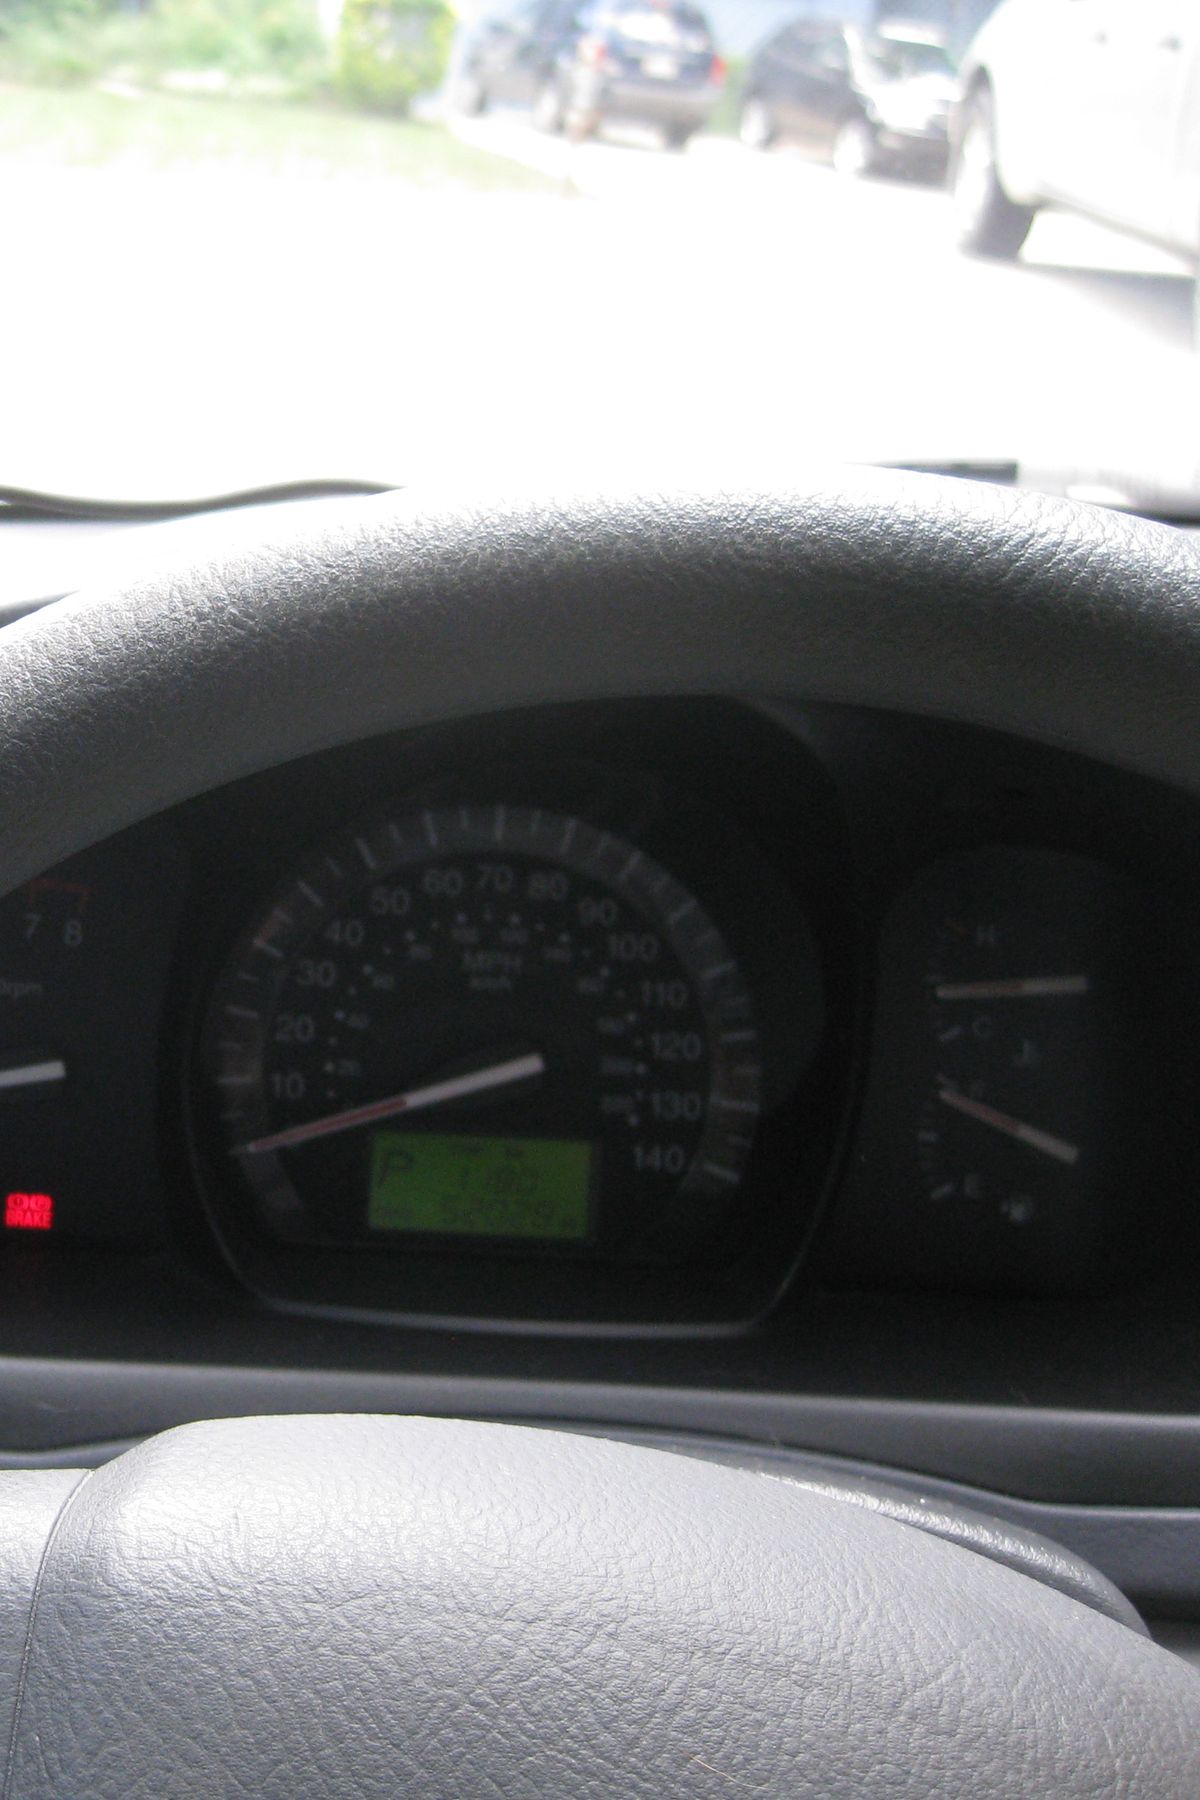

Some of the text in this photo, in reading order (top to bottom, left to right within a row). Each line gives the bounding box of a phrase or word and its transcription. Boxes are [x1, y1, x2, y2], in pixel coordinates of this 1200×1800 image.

[424, 869, 463, 897] 60
[478, 865, 513, 893] 70
[528, 871, 568, 899] 80
[370, 886, 411, 915] 50
[578, 898, 618, 927] 90
[24, 912, 42, 940] 7
[63, 917, 84, 947] 8
[324, 920, 366, 946] 40
[608, 934, 659, 963] 100
[298, 960, 337, 989] 30
[641, 980, 687, 1009] 110
[275, 1013, 316, 1042] 20
[652, 1031, 702, 1061] 120
[271, 1071, 306, 1100] 10
[653, 1091, 701, 1120] 130
[633, 1144, 685, 1174] 140
[5, 1209, 53, 1229] BRAKE
